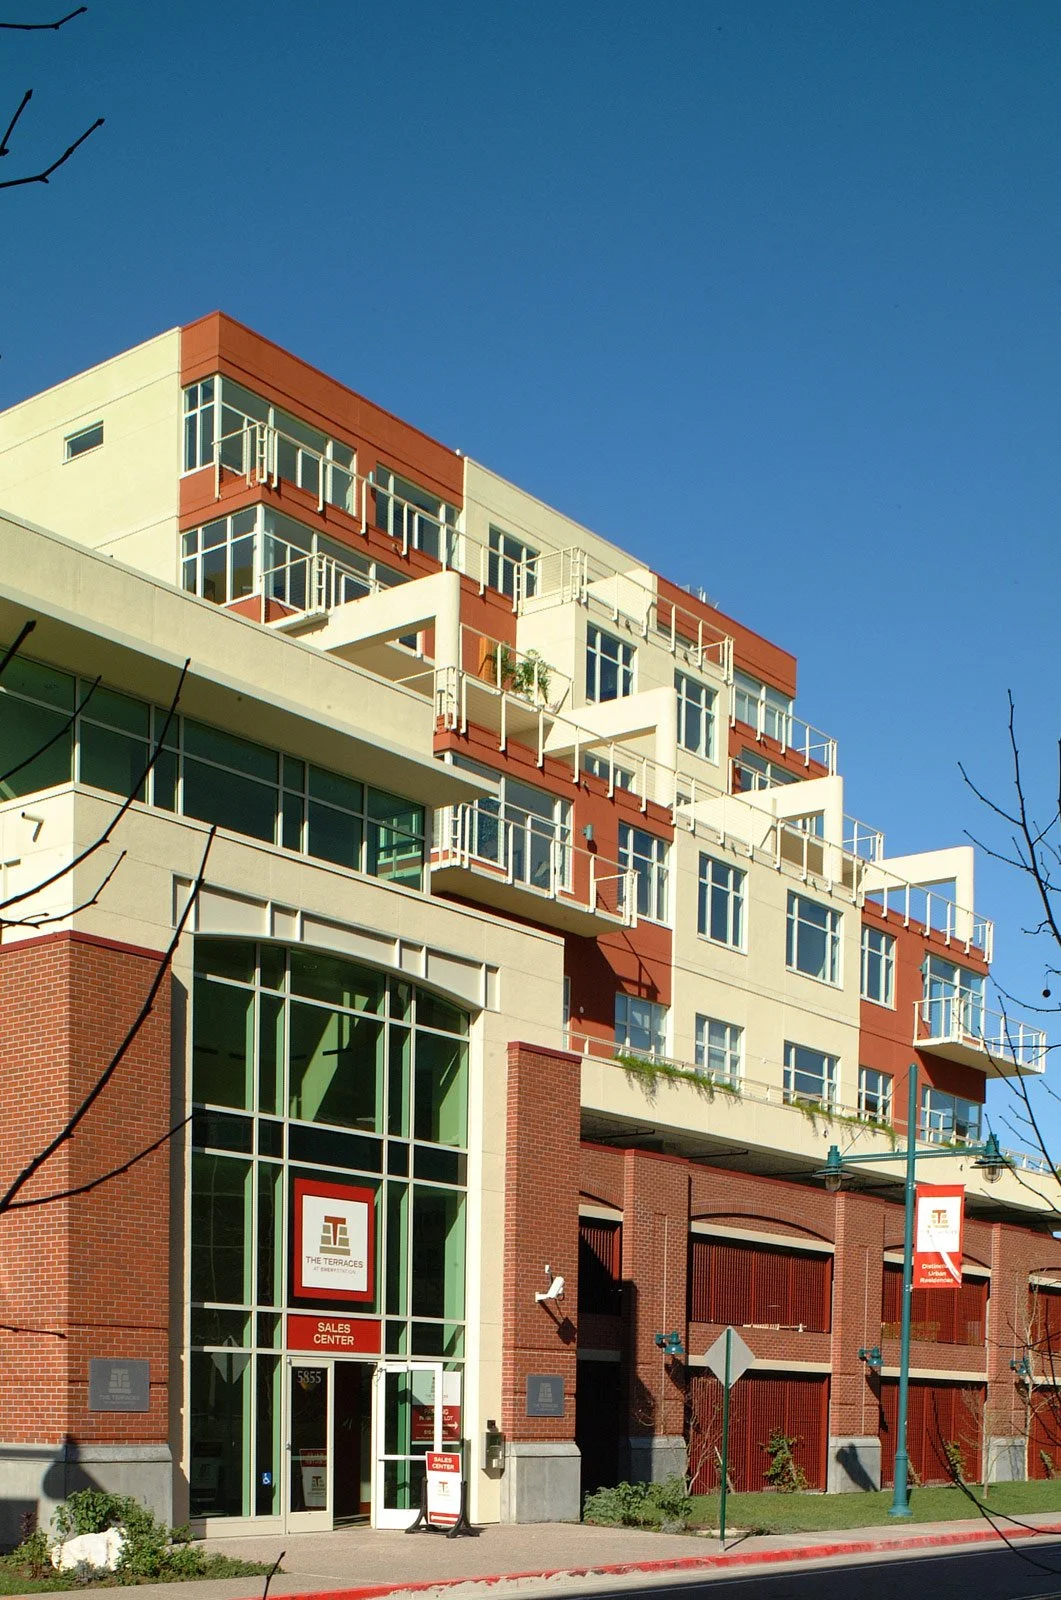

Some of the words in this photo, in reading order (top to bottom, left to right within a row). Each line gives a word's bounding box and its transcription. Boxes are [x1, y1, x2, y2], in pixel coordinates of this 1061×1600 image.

[306, 1256, 321, 1264] THE
[323, 1257, 363, 1268] TERRACES
[318, 1322, 351, 1333] SALES
[313, 1334, 354, 1345] CENTER
[297, 1370, 322, 1384] 5855
